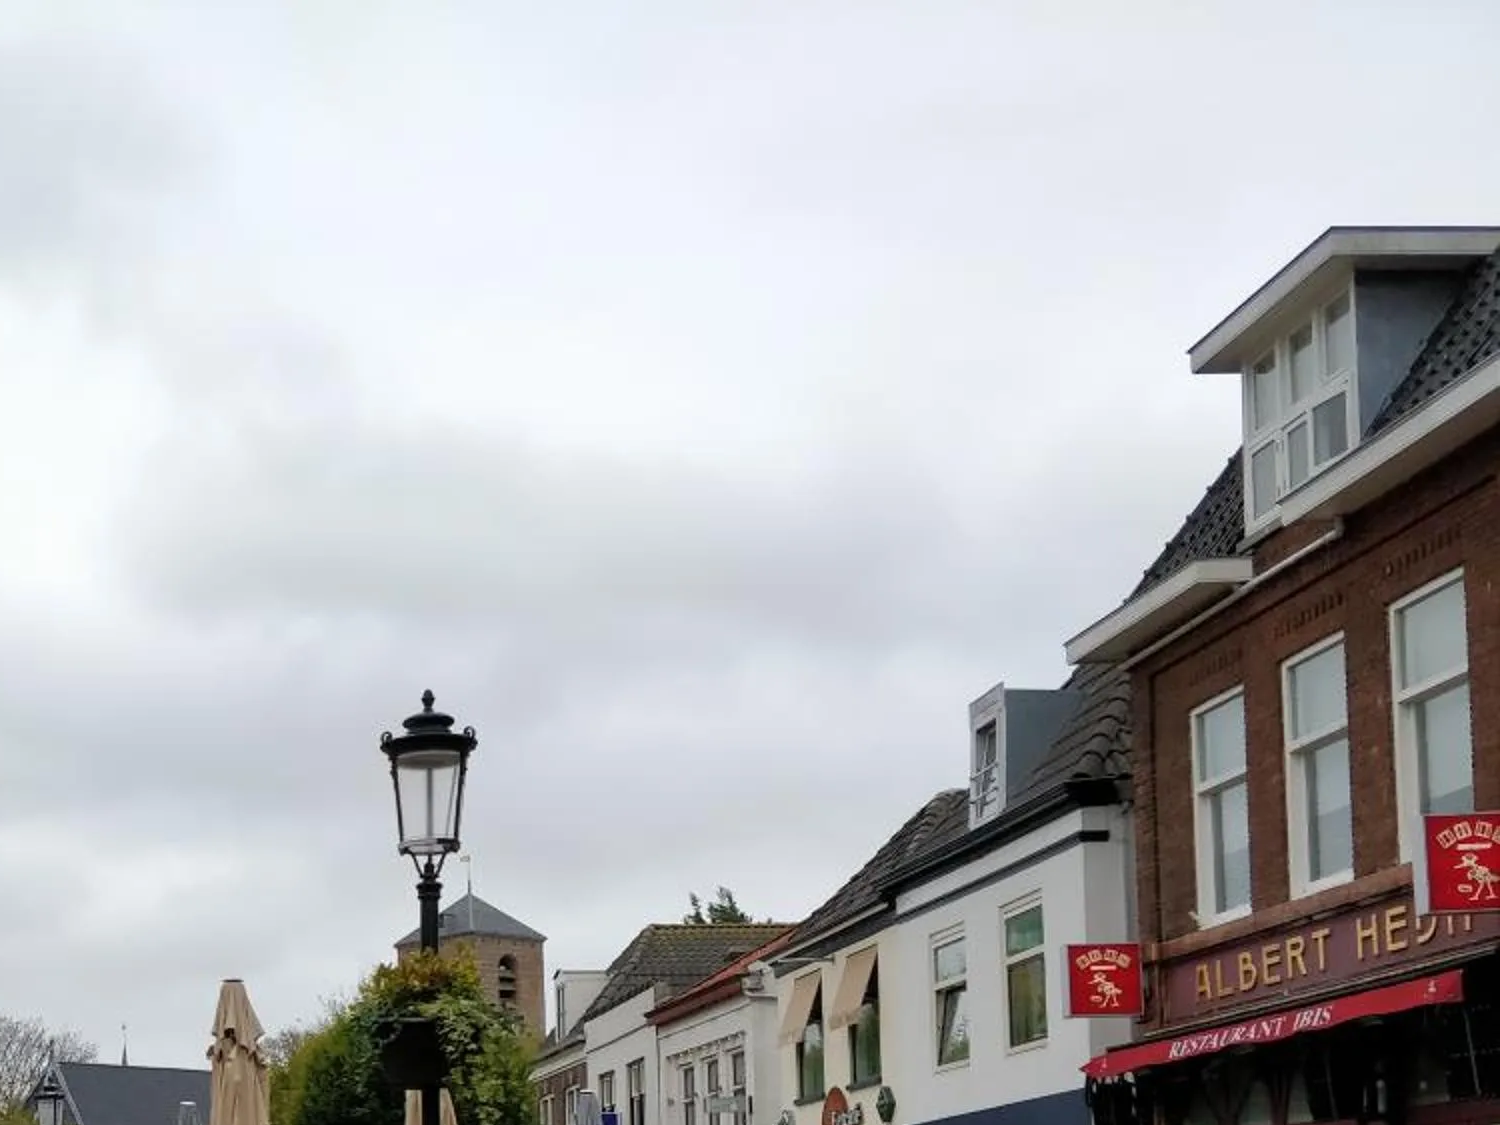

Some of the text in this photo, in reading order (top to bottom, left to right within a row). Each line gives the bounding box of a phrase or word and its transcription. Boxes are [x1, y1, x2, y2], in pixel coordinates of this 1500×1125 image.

[1195, 927, 1331, 1001] ALBERT
[1168, 1005, 1334, 1059] RESTAURANT IBIS
